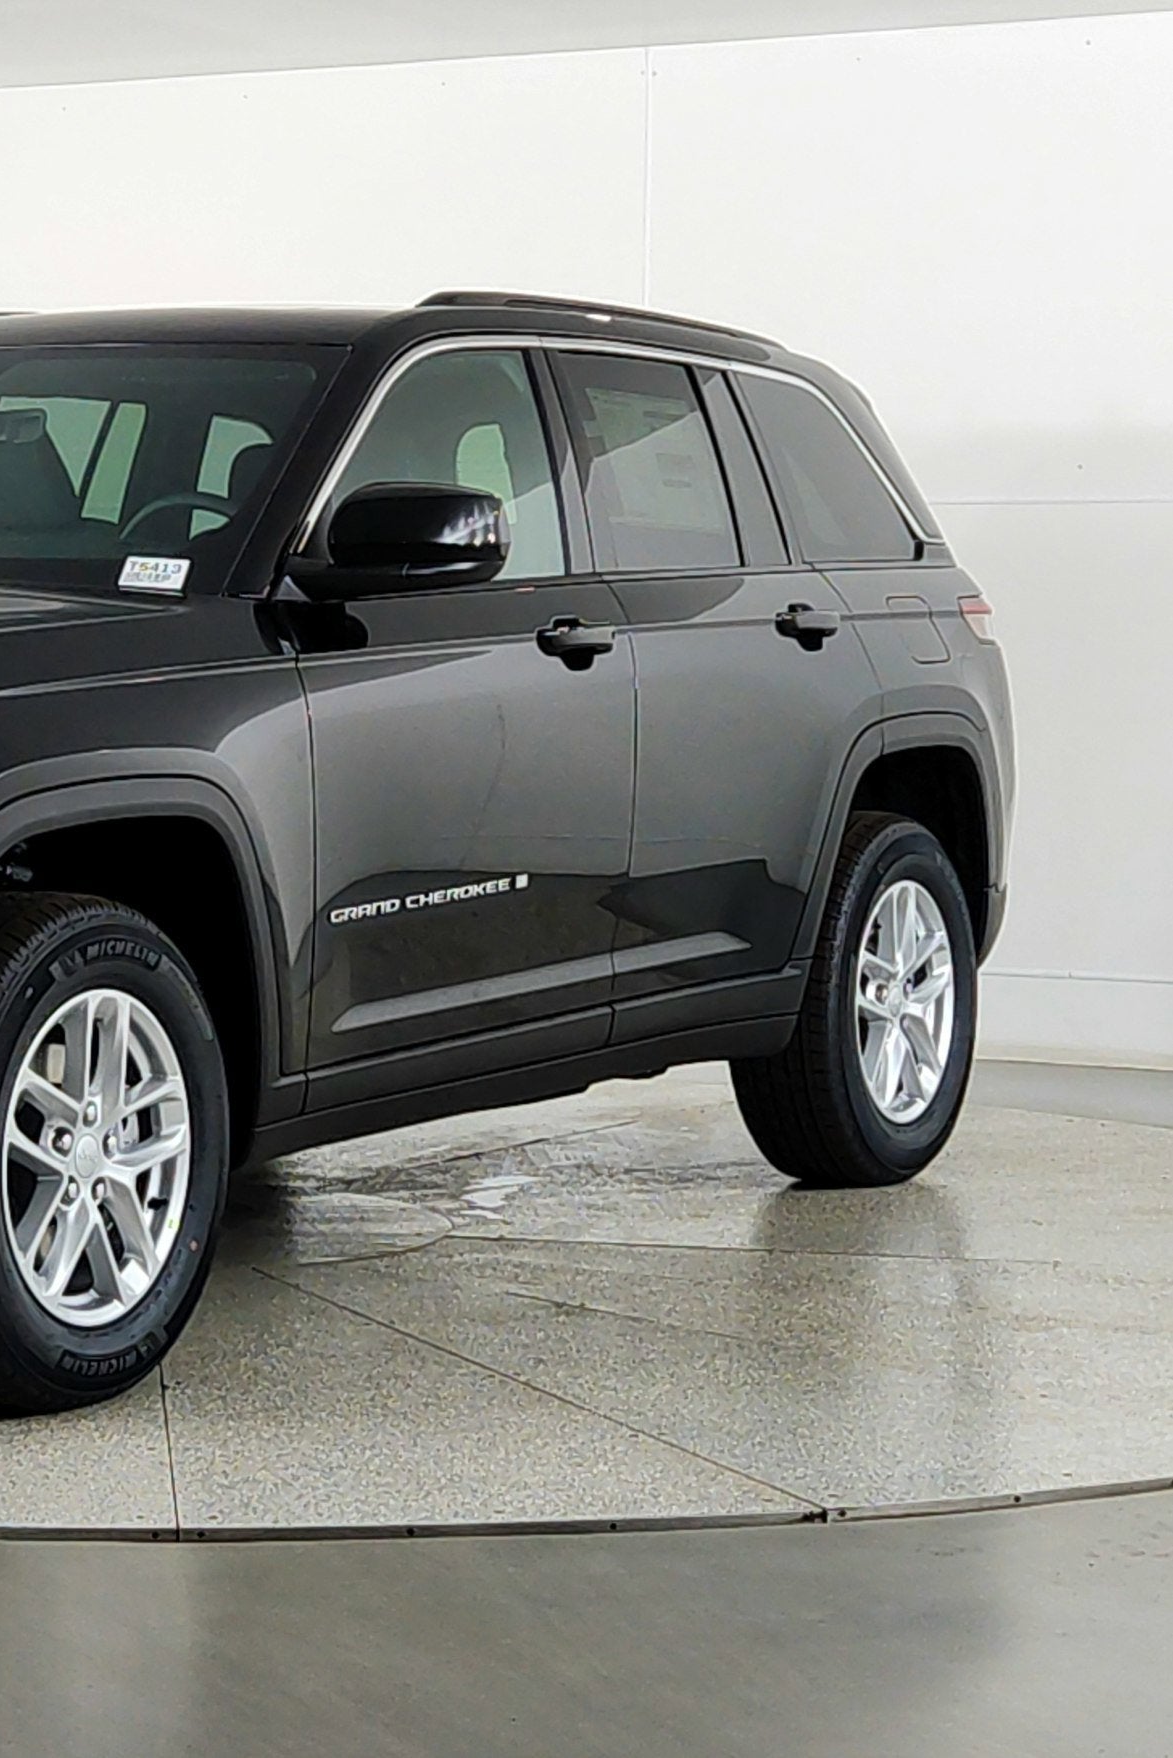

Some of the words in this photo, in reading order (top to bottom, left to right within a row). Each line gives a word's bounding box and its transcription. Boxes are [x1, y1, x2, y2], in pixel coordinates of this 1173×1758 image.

[129, 560, 183, 575] T5413
[330, 899, 401, 923] GRAND
[405, 877, 513, 909] CHEROKEE
[86, 939, 161, 968] MICHELIN
